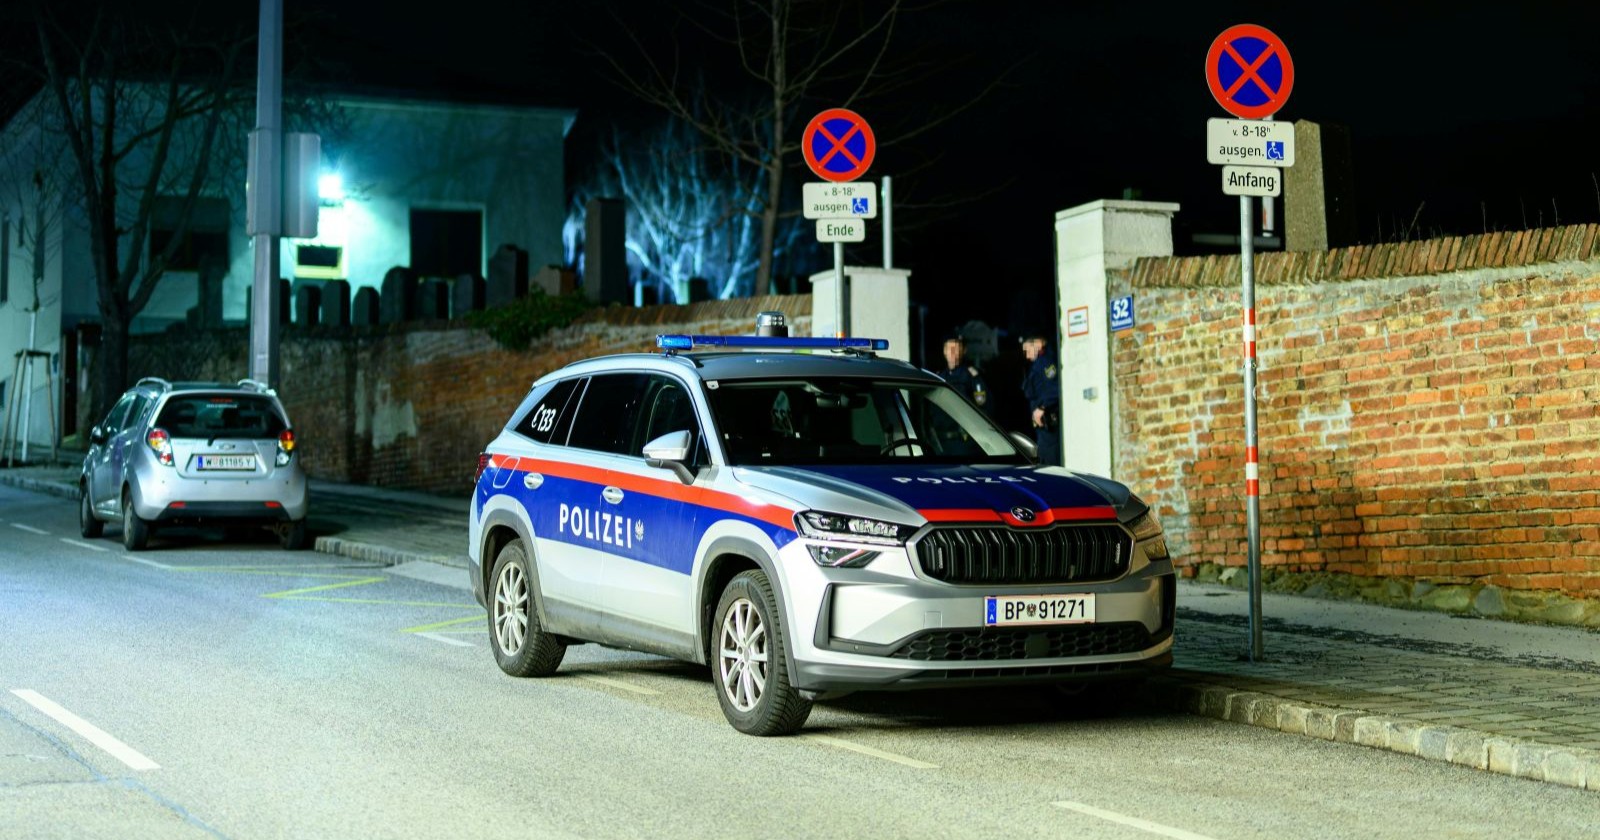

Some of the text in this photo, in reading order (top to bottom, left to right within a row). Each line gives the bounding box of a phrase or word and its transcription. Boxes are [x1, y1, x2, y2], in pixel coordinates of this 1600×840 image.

[1219, 145, 1265, 158] ausgen.
[1229, 171, 1275, 191] Anfang
[813, 203, 851, 213] ausgen.
[827, 224, 854, 236] Ende
[1113, 298, 1129, 319] 52
[537, 408, 557, 432] 133
[206, 457, 212, 466] W
[892, 475, 1037, 484] POLIZEI
[559, 502, 632, 549] POLIZEI
[1005, 599, 1085, 620] BP 91271
